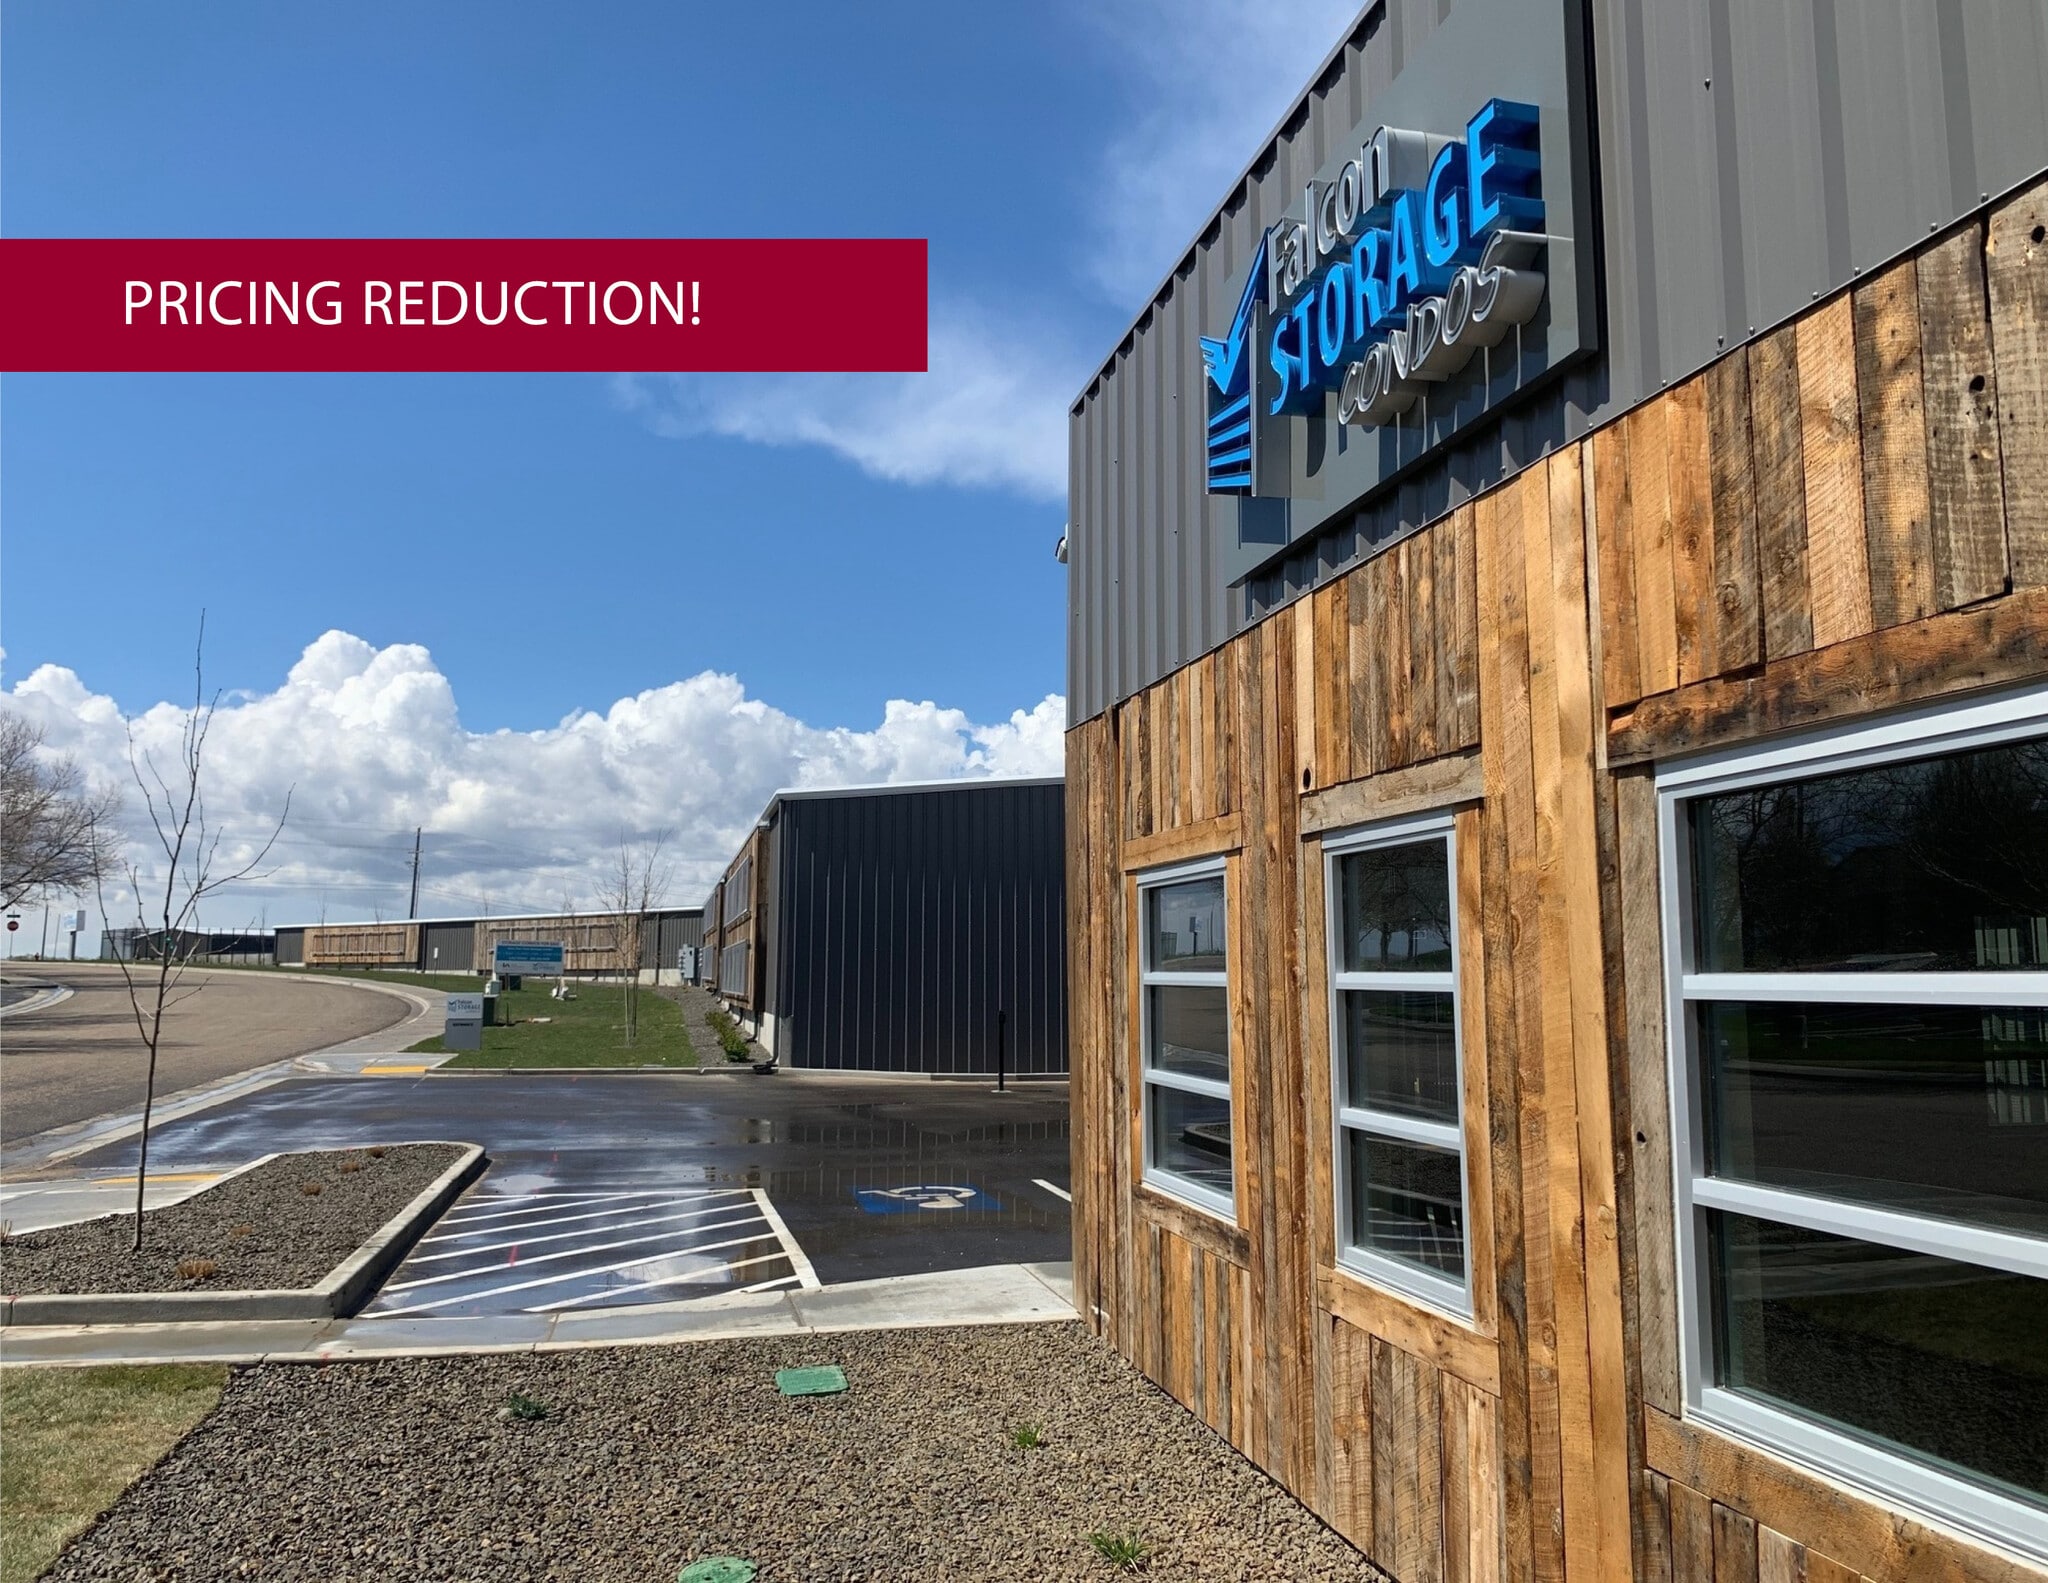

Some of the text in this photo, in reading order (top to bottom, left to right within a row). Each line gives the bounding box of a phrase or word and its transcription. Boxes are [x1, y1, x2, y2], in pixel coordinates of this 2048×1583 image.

[1267, 124, 1392, 316] Falcon
[1269, 97, 1508, 417] STORAGE
[1336, 229, 1512, 426] CONDOS
